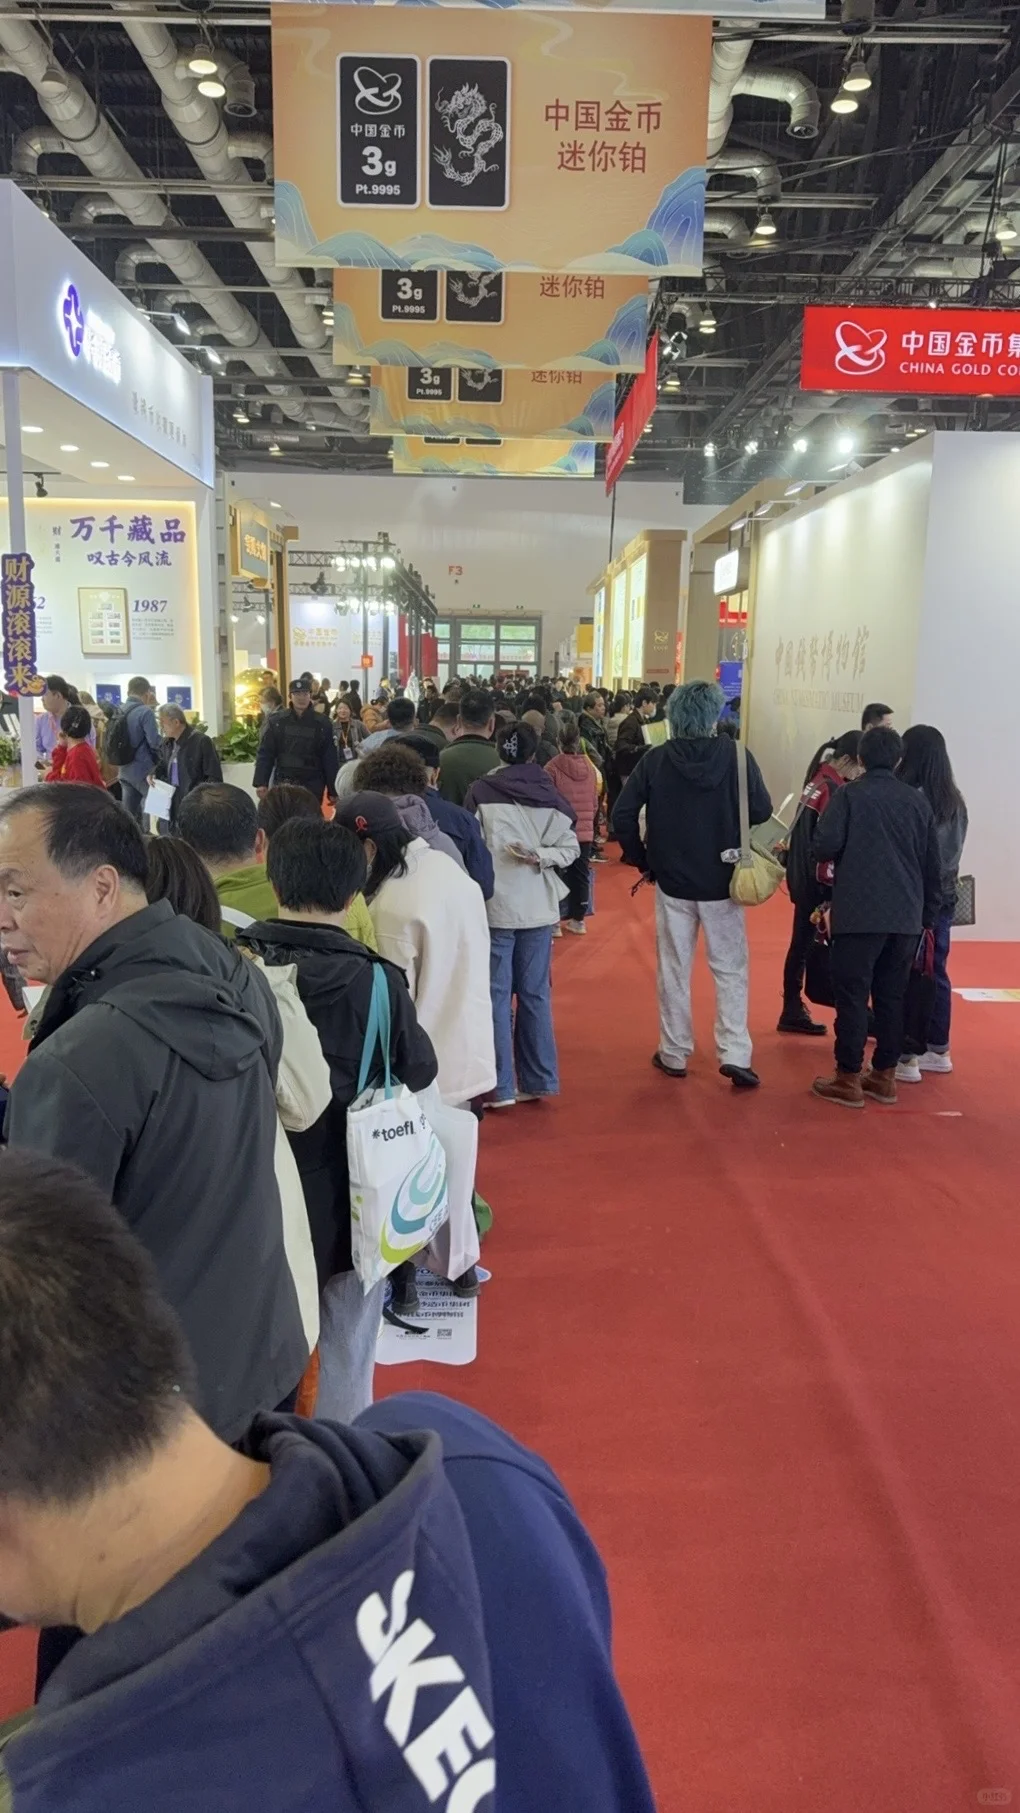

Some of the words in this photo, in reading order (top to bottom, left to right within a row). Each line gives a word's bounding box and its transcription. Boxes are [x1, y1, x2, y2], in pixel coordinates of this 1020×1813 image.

[545, 98, 662, 134] 中国金币
[350, 123, 406, 138] 中国金币
[361, 145, 397, 177] 3g
[557, 139, 647, 173] 迷你铂
[355, 183, 401, 196] Pt.9995
[396, 277, 423, 300] 3g
[540, 275, 605, 299] 迷你铂
[391, 304, 426, 315] Pt.9995
[419, 367, 441, 386] 3g
[899, 361, 945, 375] CHINA
[951, 362, 992, 376] GOLD
[997, 363, 1020, 377] CO
[69, 514, 187, 545] 万千藏品
[86, 549, 173, 568] 叹古今风流
[448, 565, 463, 576] F3
[131, 598, 169, 613] 1987
[5, 556, 33, 688] 财源滚滚来
